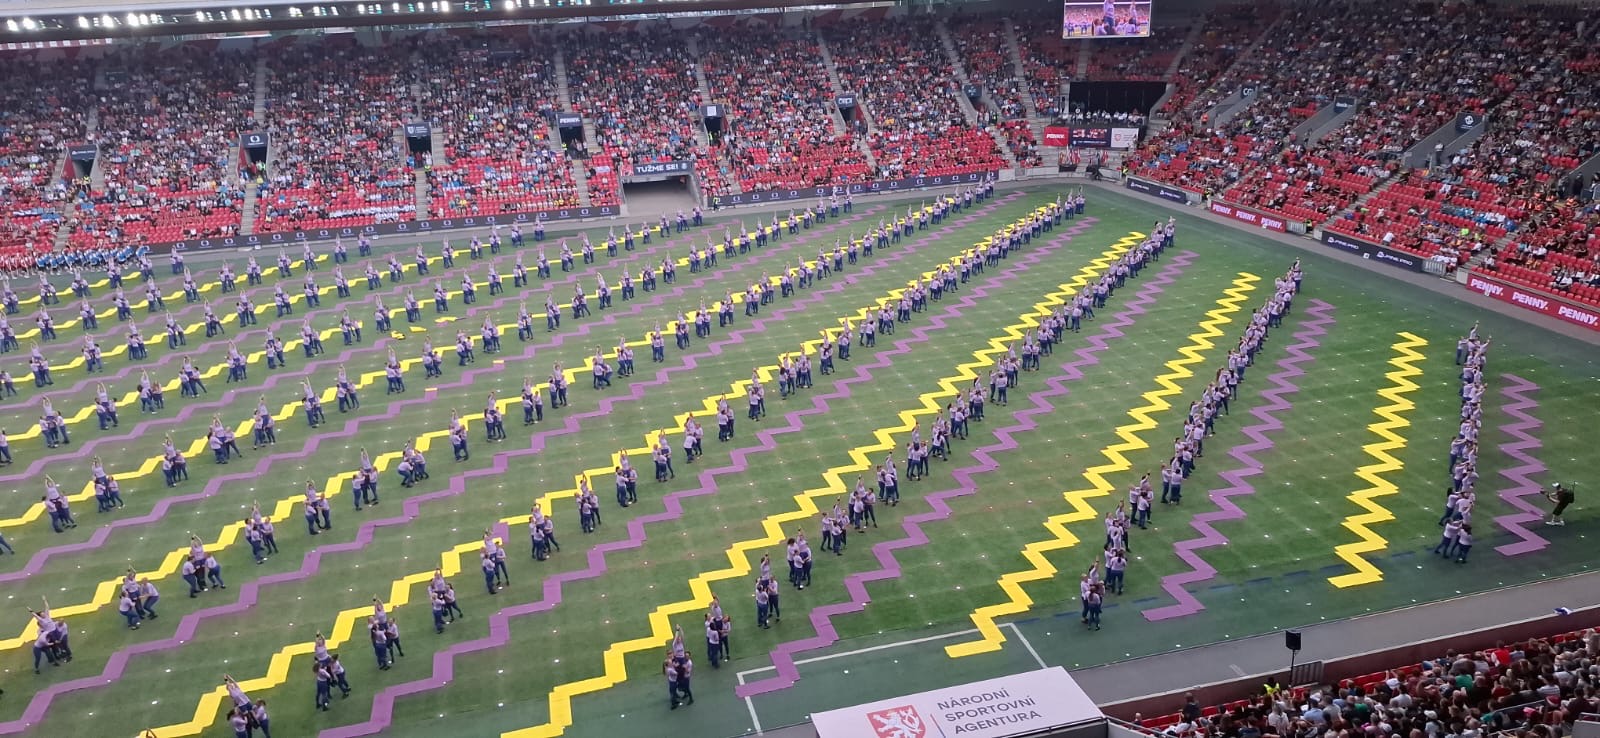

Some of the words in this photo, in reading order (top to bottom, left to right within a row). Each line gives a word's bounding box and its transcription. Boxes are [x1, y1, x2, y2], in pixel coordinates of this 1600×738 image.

[636, 164, 665, 173] TUŽME
[665, 163, 678, 171] SE!
[1470, 278, 1504, 296] PENNY.
[1512, 292, 1549, 311] PENNY.
[1558, 305, 1598, 327] PENNY.
[937, 687, 1010, 710] NÁRODNÍ
[945, 695, 1036, 722] SPORTOVNÍ
[955, 710, 1042, 734] AGENTURA
